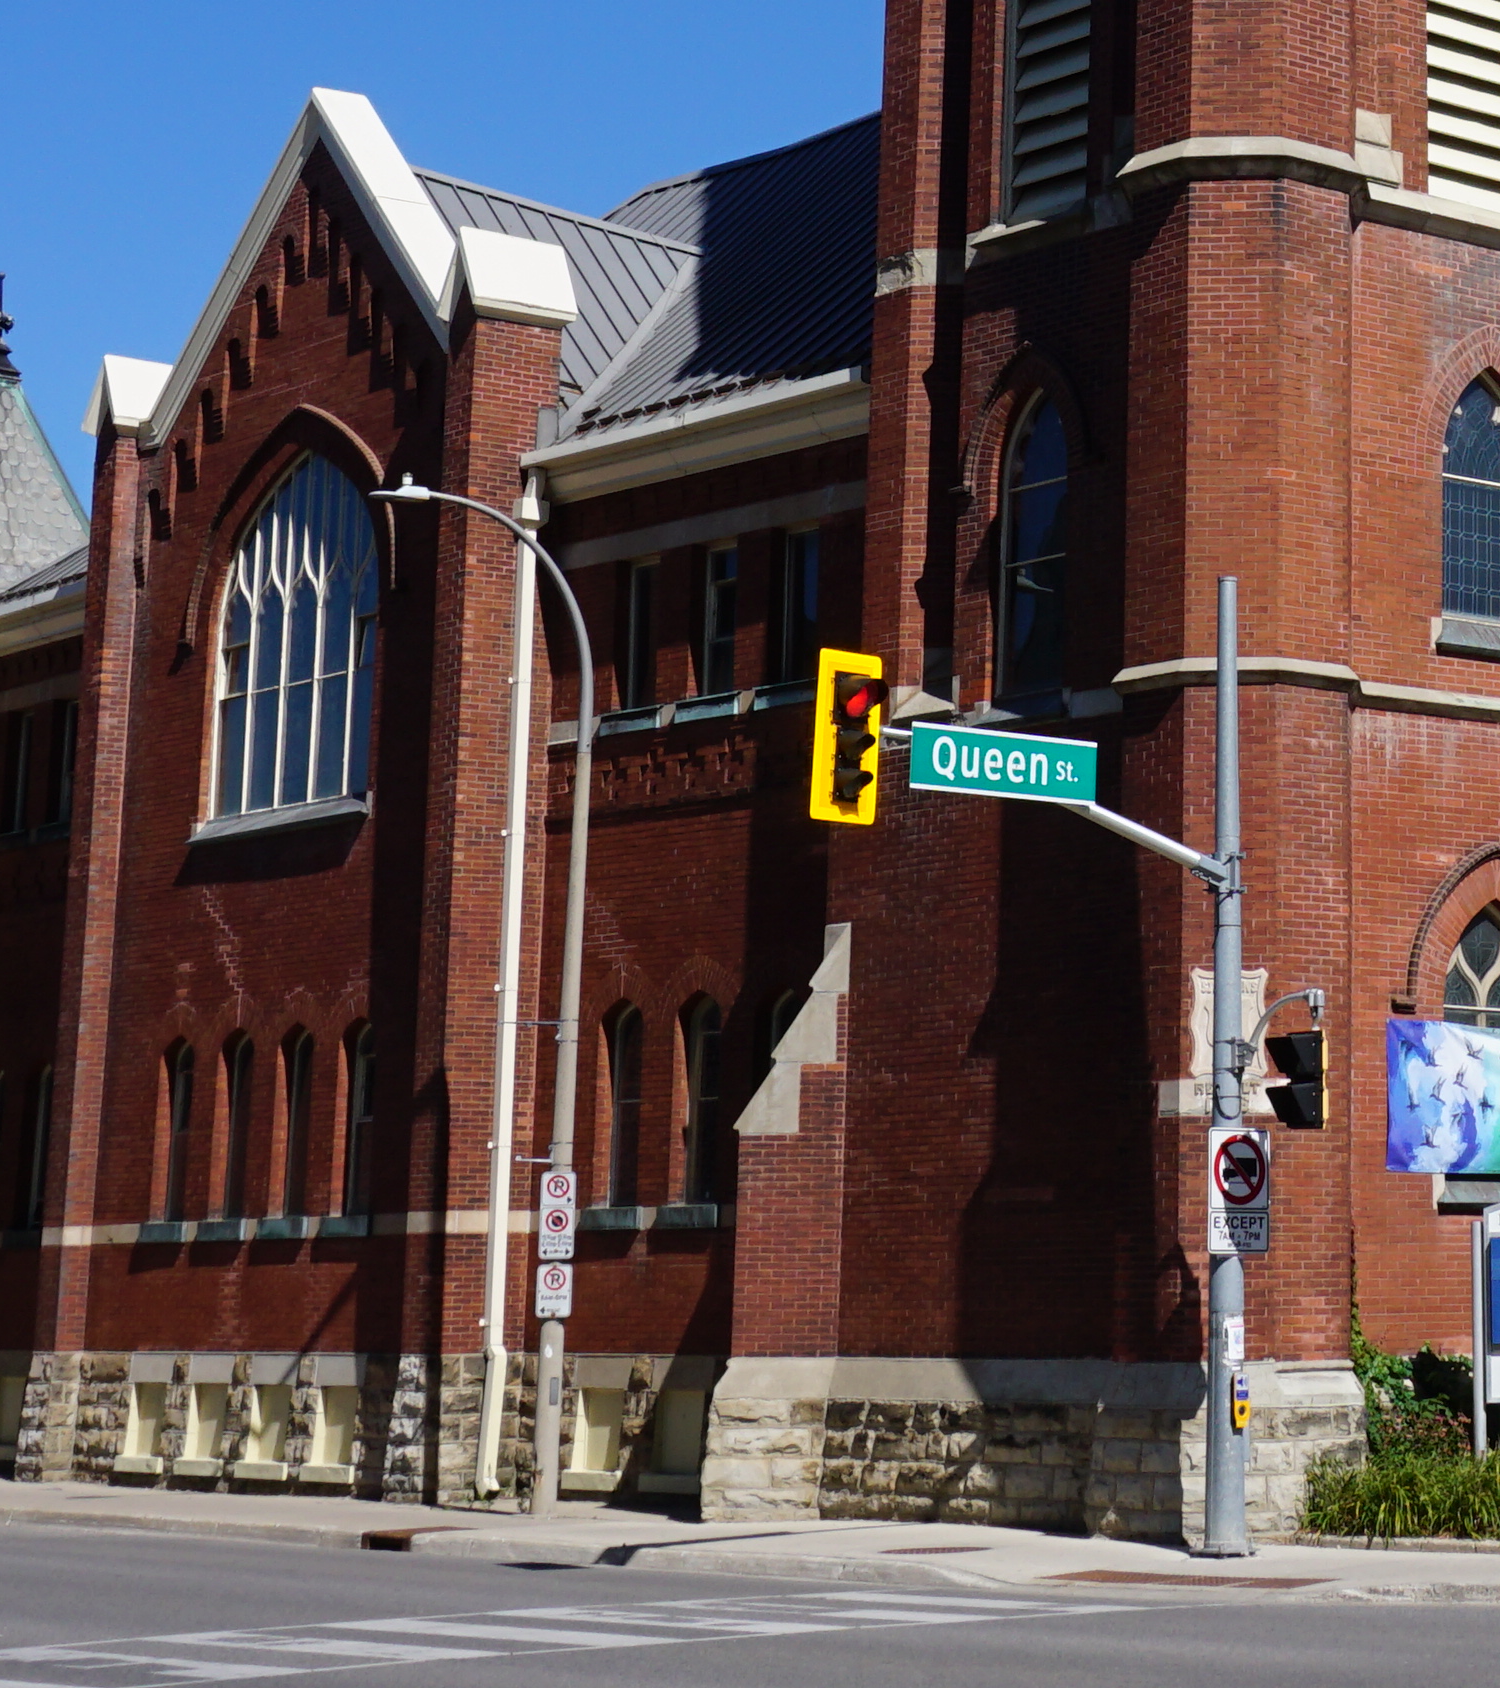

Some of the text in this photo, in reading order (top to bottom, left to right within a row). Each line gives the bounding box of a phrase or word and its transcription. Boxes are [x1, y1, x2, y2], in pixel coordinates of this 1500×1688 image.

[932, 736, 1048, 786] Queen
[1213, 1216, 1265, 1229] EXCEPT
[1218, 1231, 1235, 1241] 7AM
[1243, 1231, 1260, 1241] 7PM
